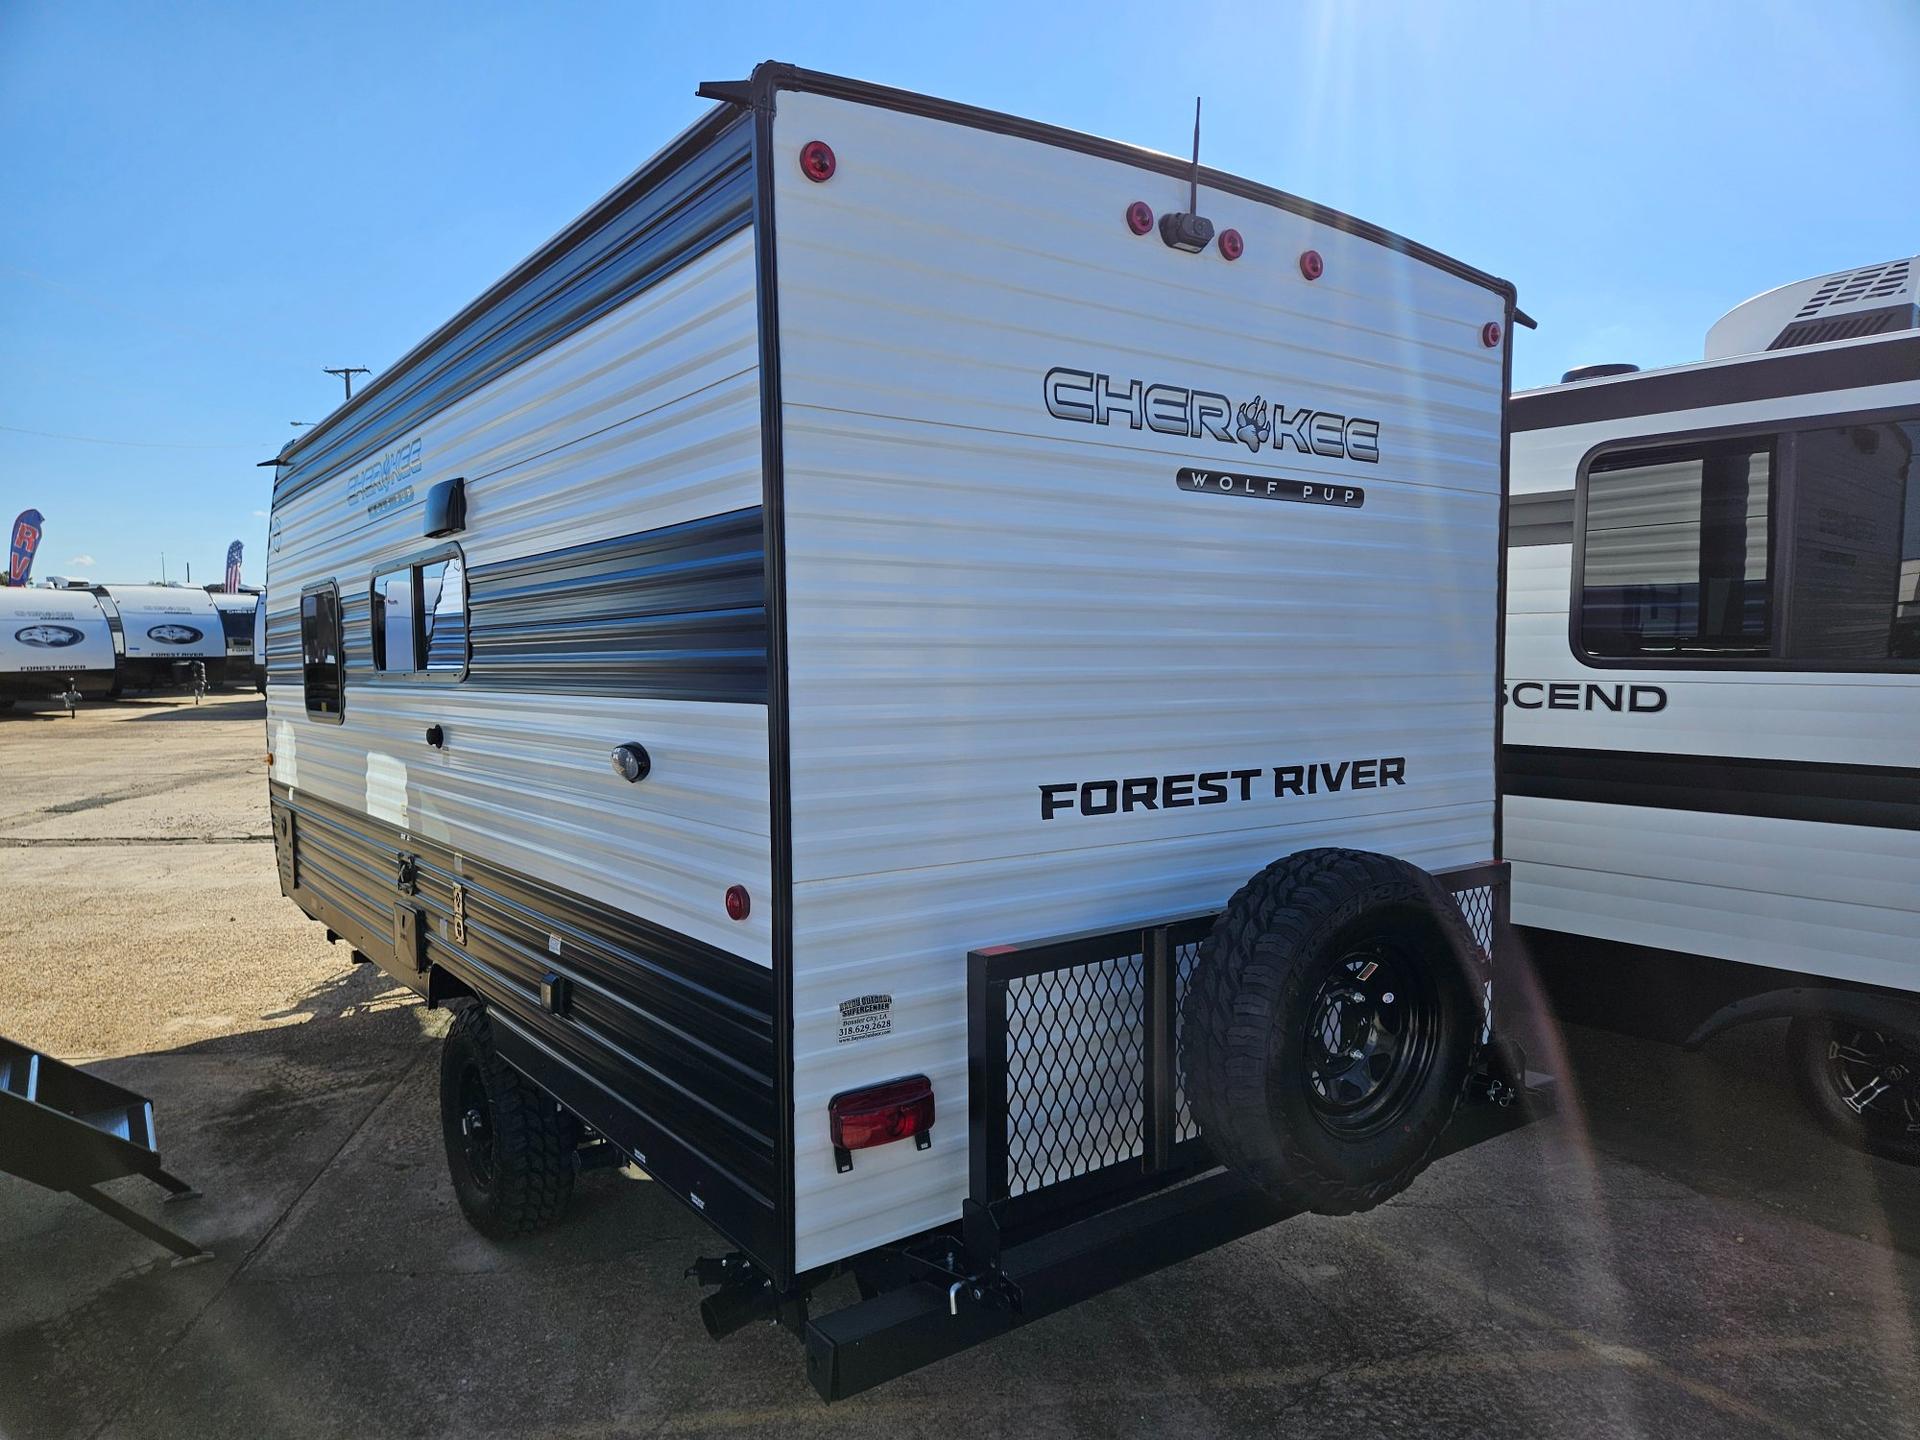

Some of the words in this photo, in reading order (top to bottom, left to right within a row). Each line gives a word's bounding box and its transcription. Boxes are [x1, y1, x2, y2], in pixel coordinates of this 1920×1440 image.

[1191, 471, 1278, 495] WOLF
[1303, 485, 1356, 504] PUP
[1503, 681, 1668, 713] CEND
[1038, 768, 1262, 820] FOREST
[1272, 756, 1406, 798] RIVER
[842, 1003, 890, 1017] SUPERCENTER
[839, 1020, 891, 1036] 318.629.2628
